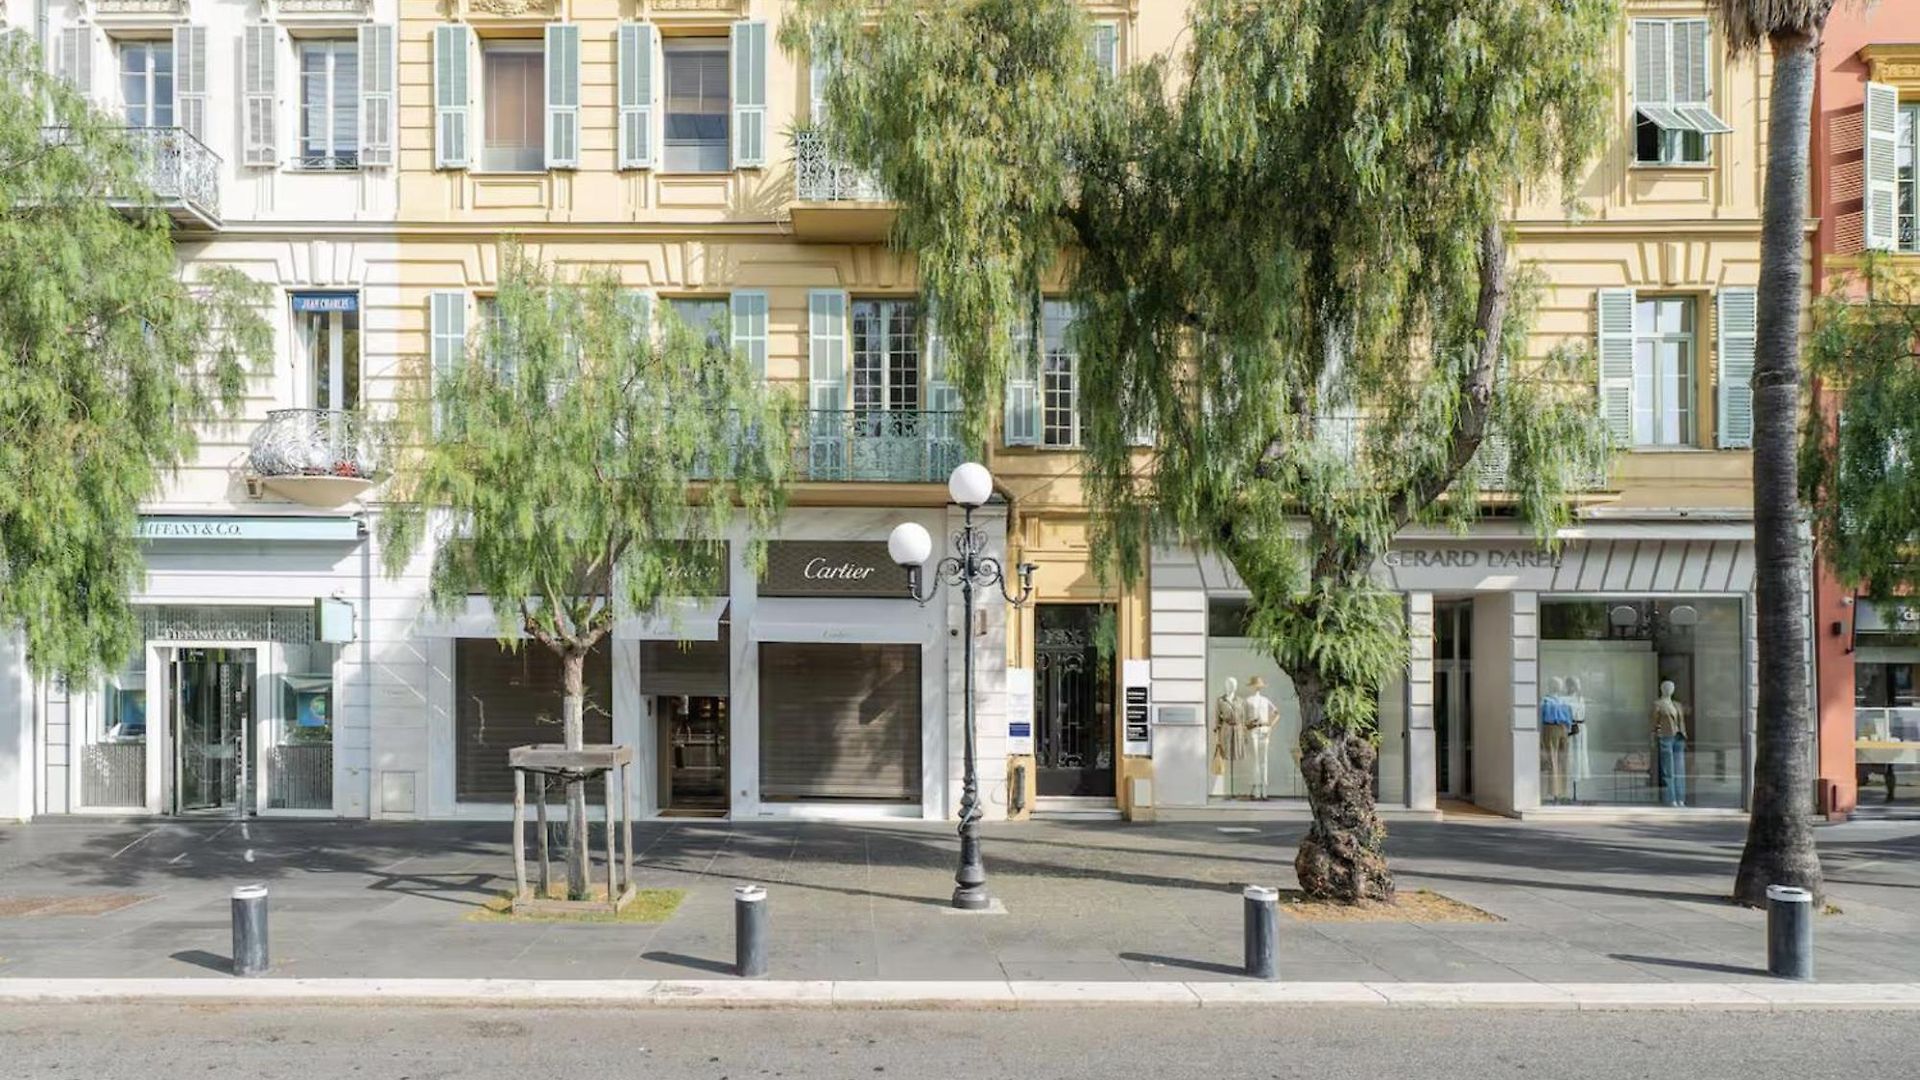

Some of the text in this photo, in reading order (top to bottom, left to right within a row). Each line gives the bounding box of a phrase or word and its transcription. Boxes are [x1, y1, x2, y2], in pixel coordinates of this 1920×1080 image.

[803, 556, 876, 580] Cartier
[1383, 550, 1562, 568] GERARD DAREL
